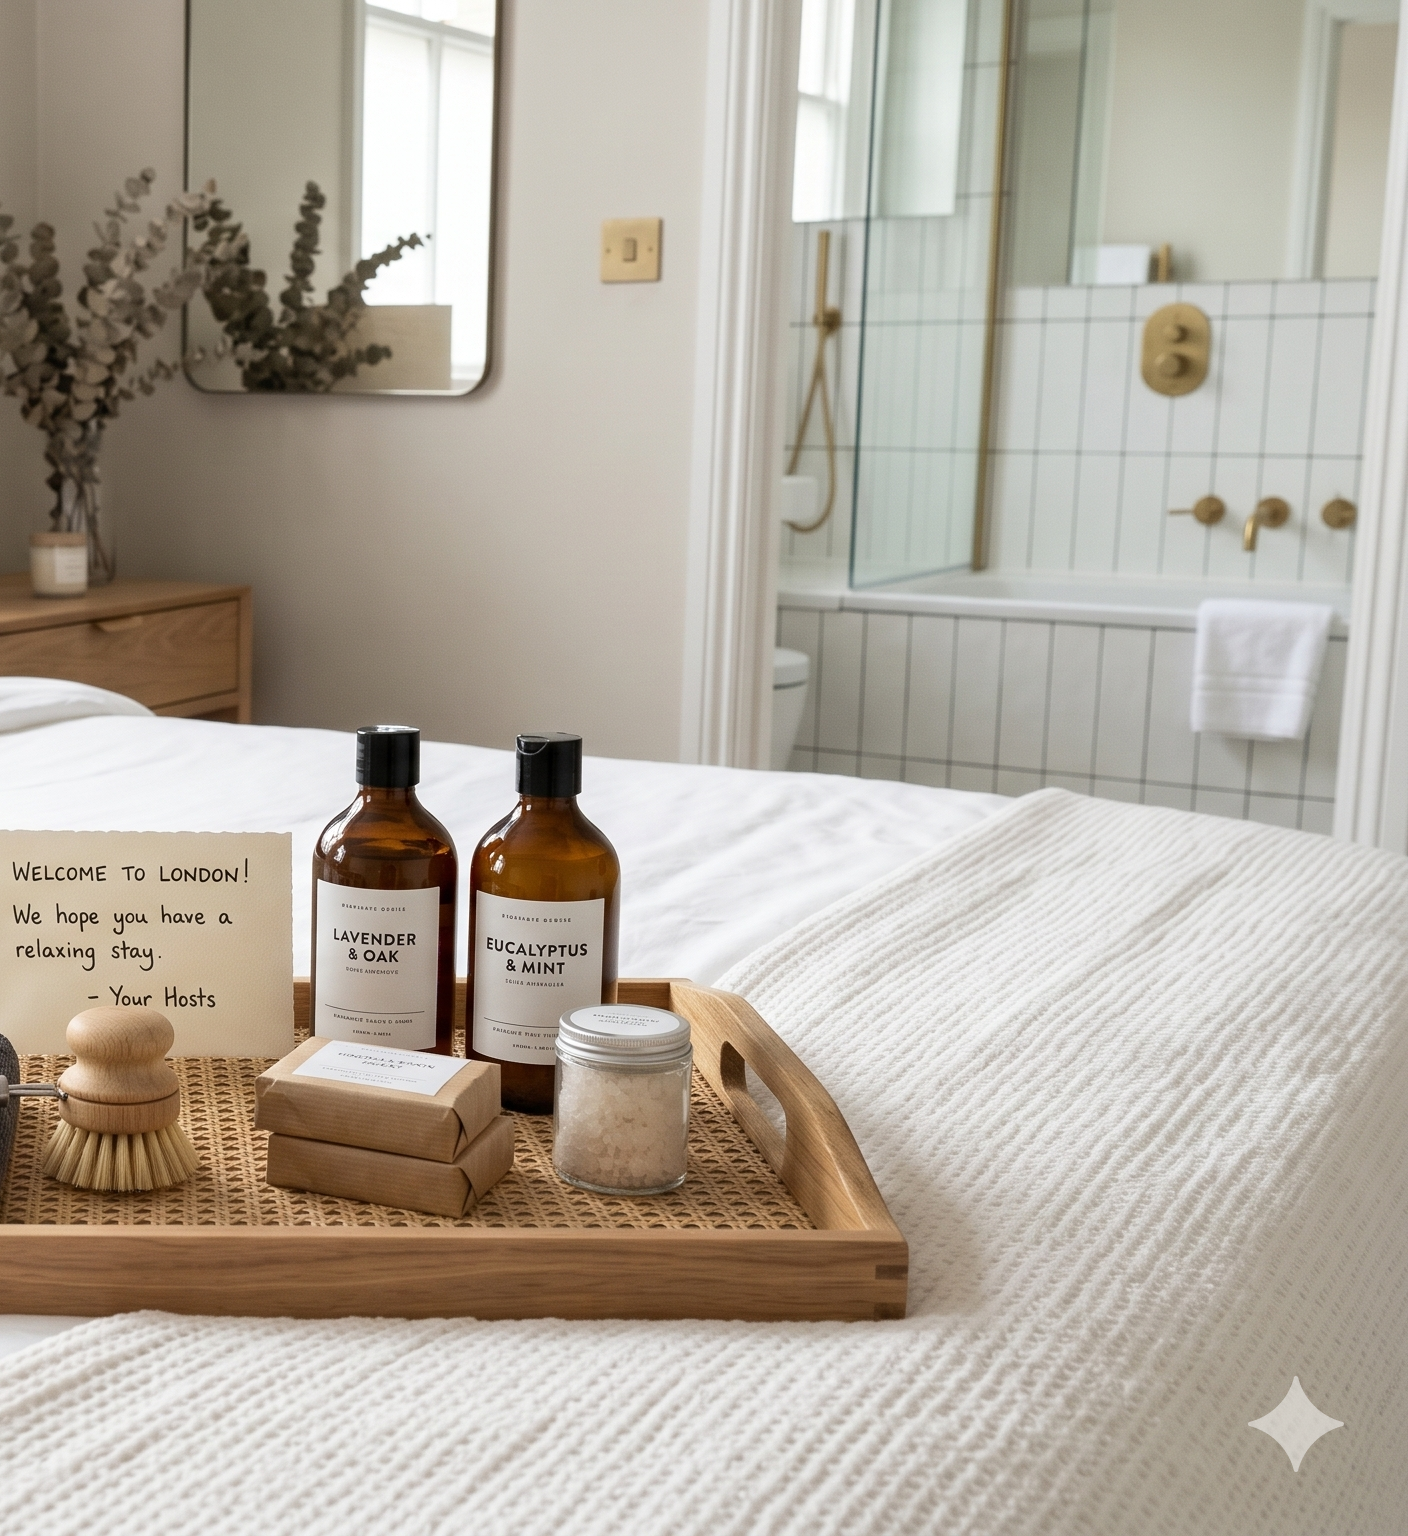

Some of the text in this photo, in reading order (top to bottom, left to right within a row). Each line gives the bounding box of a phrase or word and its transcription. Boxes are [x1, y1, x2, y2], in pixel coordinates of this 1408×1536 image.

[13, 858, 249, 883] WELCOME TO LONDON!
[13, 903, 233, 935] We hope you have a
[334, 928, 416, 946] LAVENDER
[487, 937, 588, 957] EUCALYPTUS
[16, 938, 162, 971] relaxing stay.
[348, 948, 399, 963] & OAK
[506, 959, 565, 975] & MINT
[109, 985, 153, 1007] Your
[165, 986, 216, 1008] Hosts
